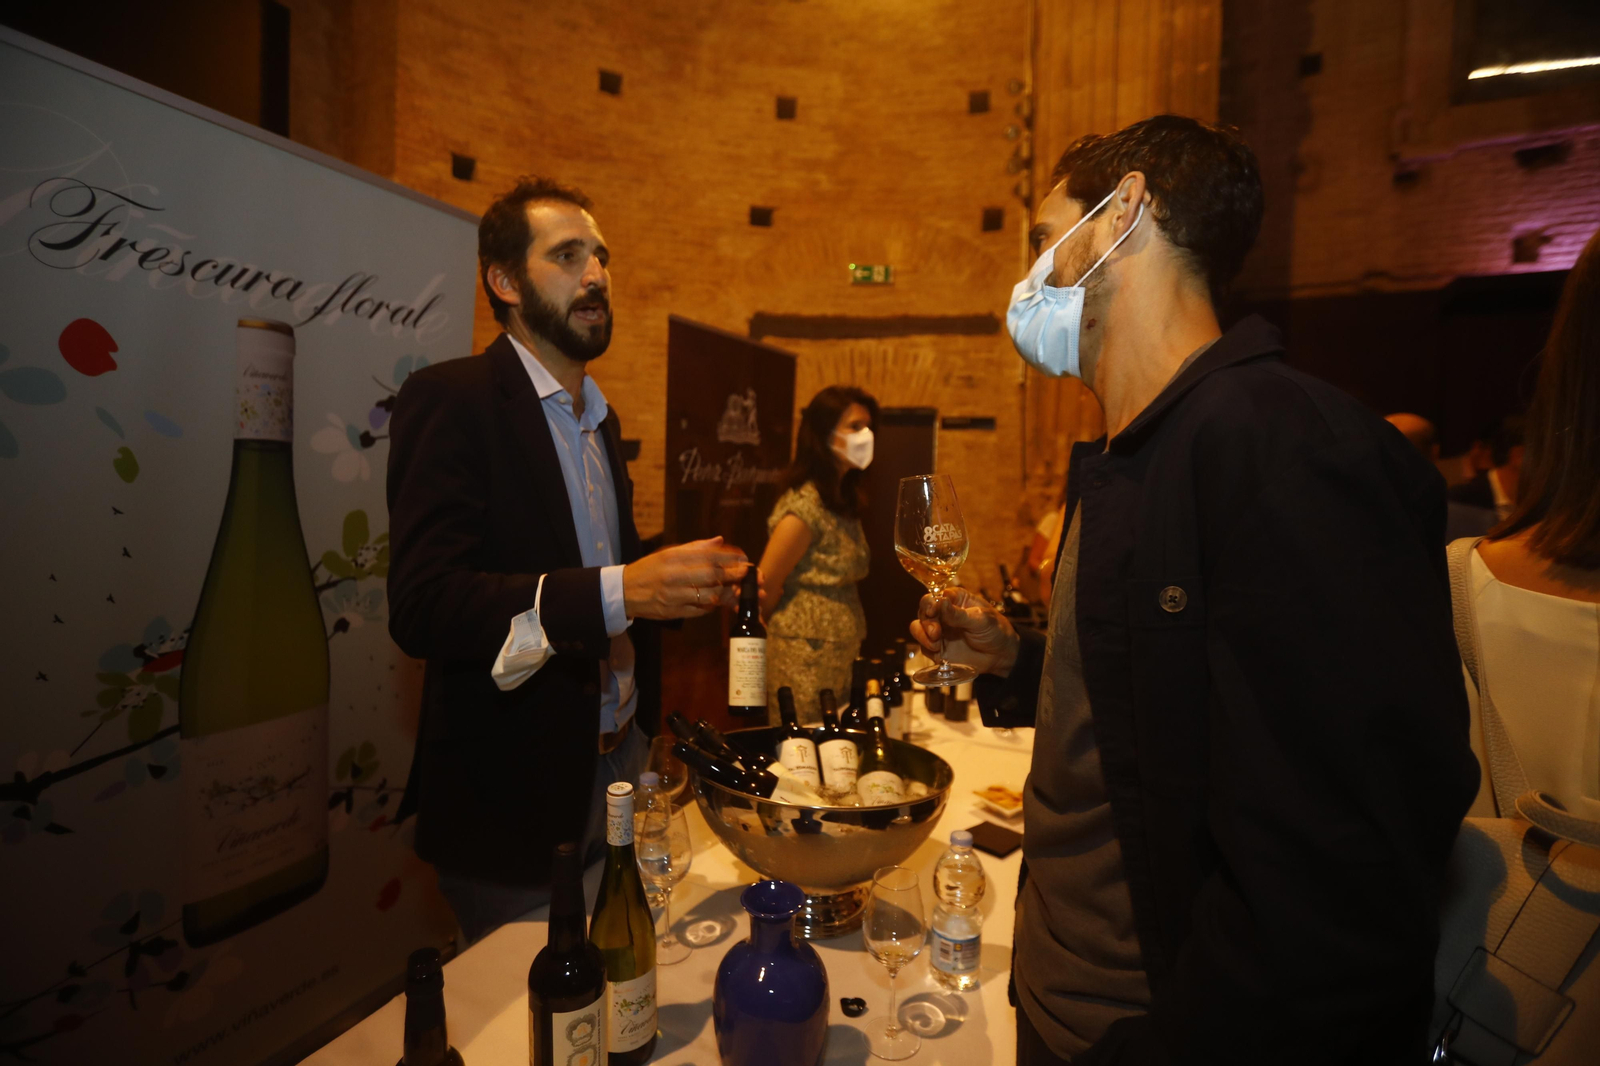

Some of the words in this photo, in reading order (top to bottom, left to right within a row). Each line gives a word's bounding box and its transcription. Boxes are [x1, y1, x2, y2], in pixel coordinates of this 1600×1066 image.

[28, 177, 304, 301] Frescura
[294, 271, 446, 330] floral
[933, 523, 956, 532] CATA
[937, 530, 963, 541] TAPAS
